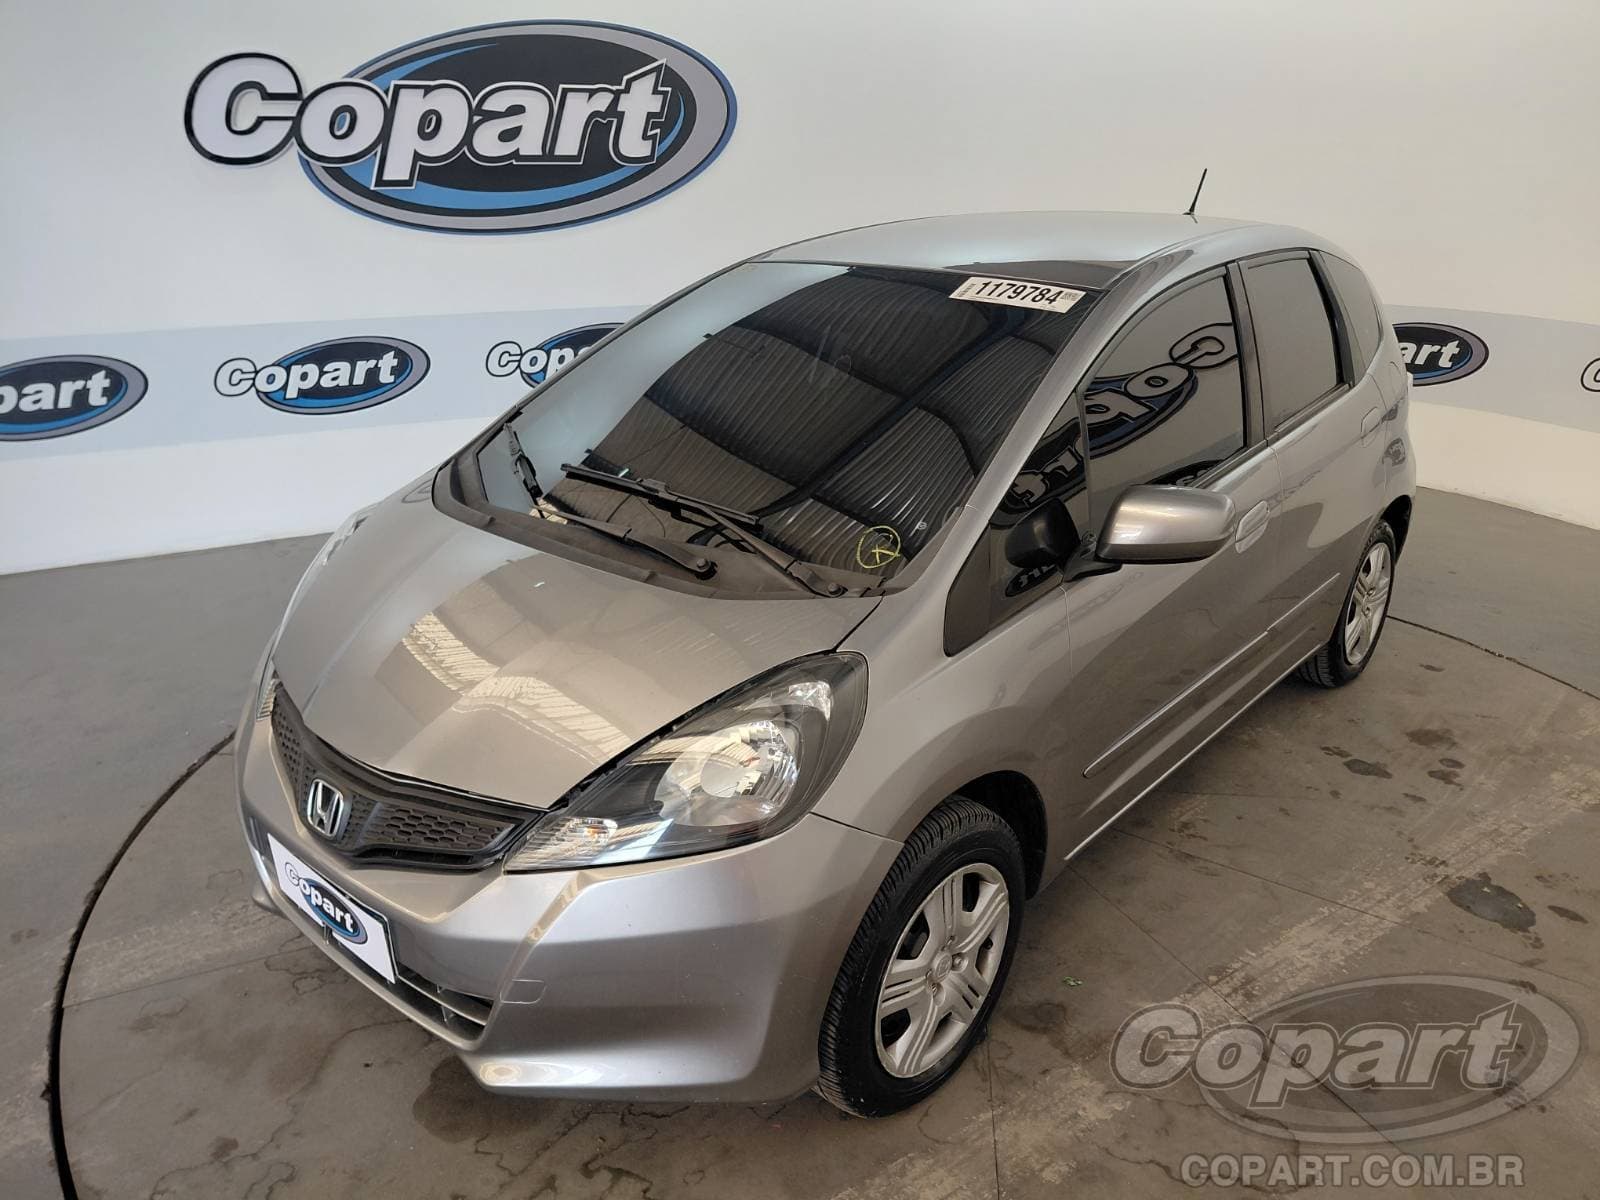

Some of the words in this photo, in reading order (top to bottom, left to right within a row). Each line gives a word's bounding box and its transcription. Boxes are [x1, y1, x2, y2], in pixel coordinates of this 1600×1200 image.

[185, 52, 672, 189] Copart
[975, 280, 1065, 305] 1179784
[213, 349, 399, 400] Copart
[285, 863, 354, 933] Copart
